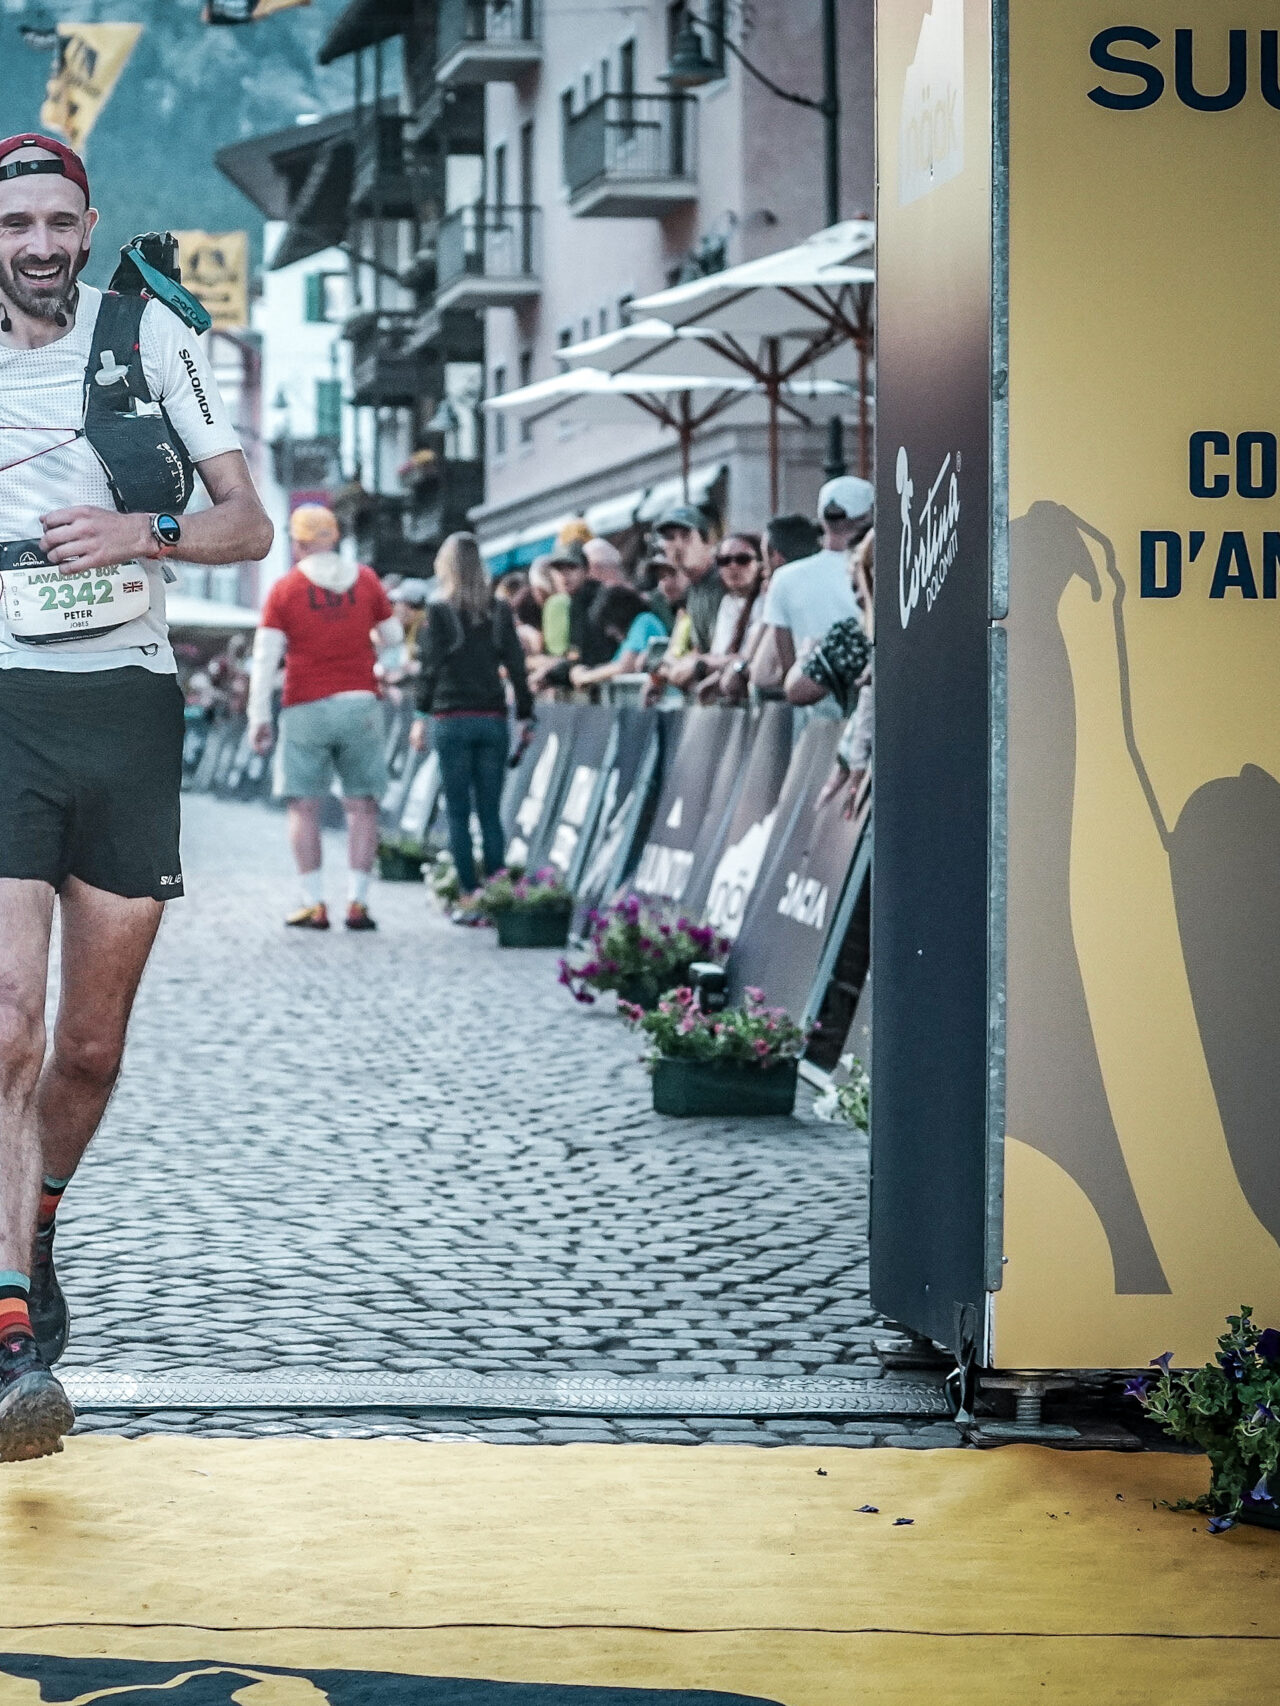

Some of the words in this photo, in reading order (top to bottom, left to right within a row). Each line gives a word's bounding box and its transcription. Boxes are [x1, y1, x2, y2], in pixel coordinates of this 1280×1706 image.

[178, 348, 215, 426] SALOMON
[896, 446, 960, 629] Cortina
[926, 528, 959, 613] DOLOMITI
[1140, 530, 1280, 599] D'A
[38, 579, 114, 611] 2342
[64, 610, 93, 620] PETER
